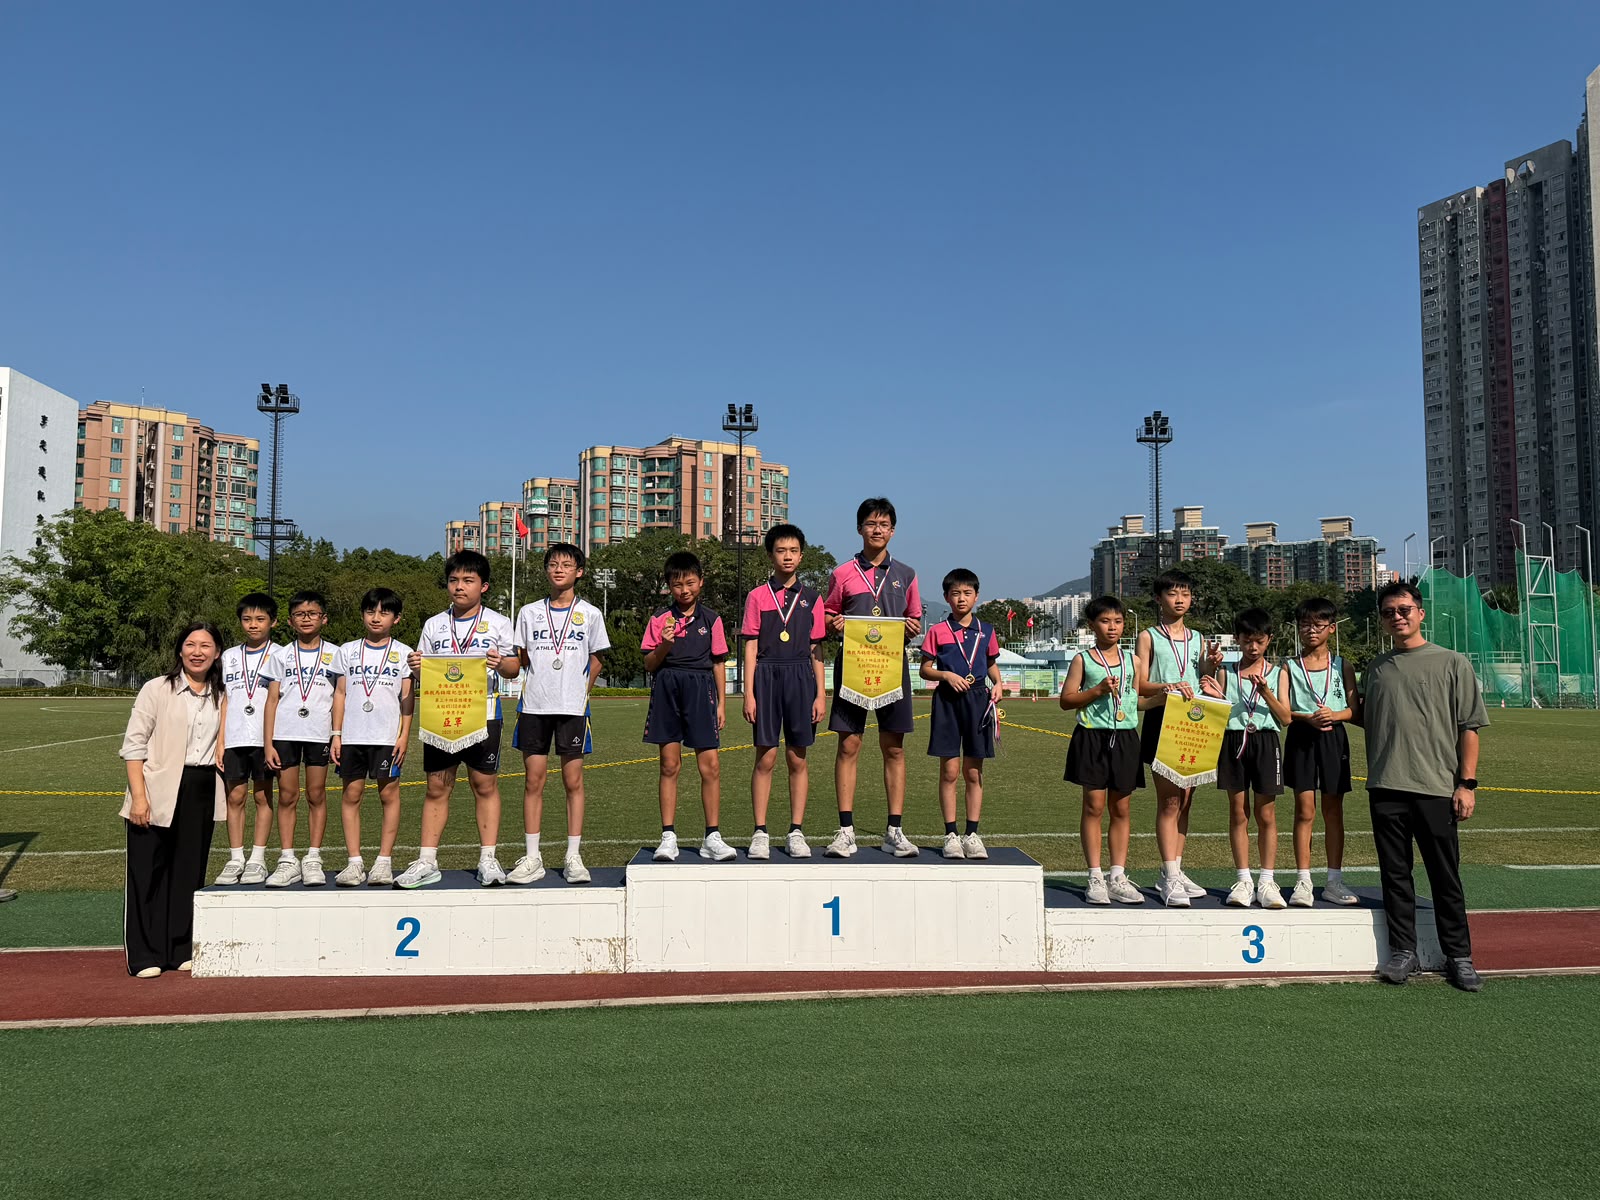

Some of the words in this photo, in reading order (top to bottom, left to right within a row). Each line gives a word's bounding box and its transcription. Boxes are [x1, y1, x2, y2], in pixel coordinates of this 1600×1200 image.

[349, 665, 400, 677] BCKLAS
[864, 676, 882, 686] 冠軍
[443, 717, 462, 727] 亞軍
[1179, 753, 1197, 765] 季軍
[822, 895, 840, 936] 1
[395, 916, 421, 957] 2
[1241, 925, 1265, 964] 3
